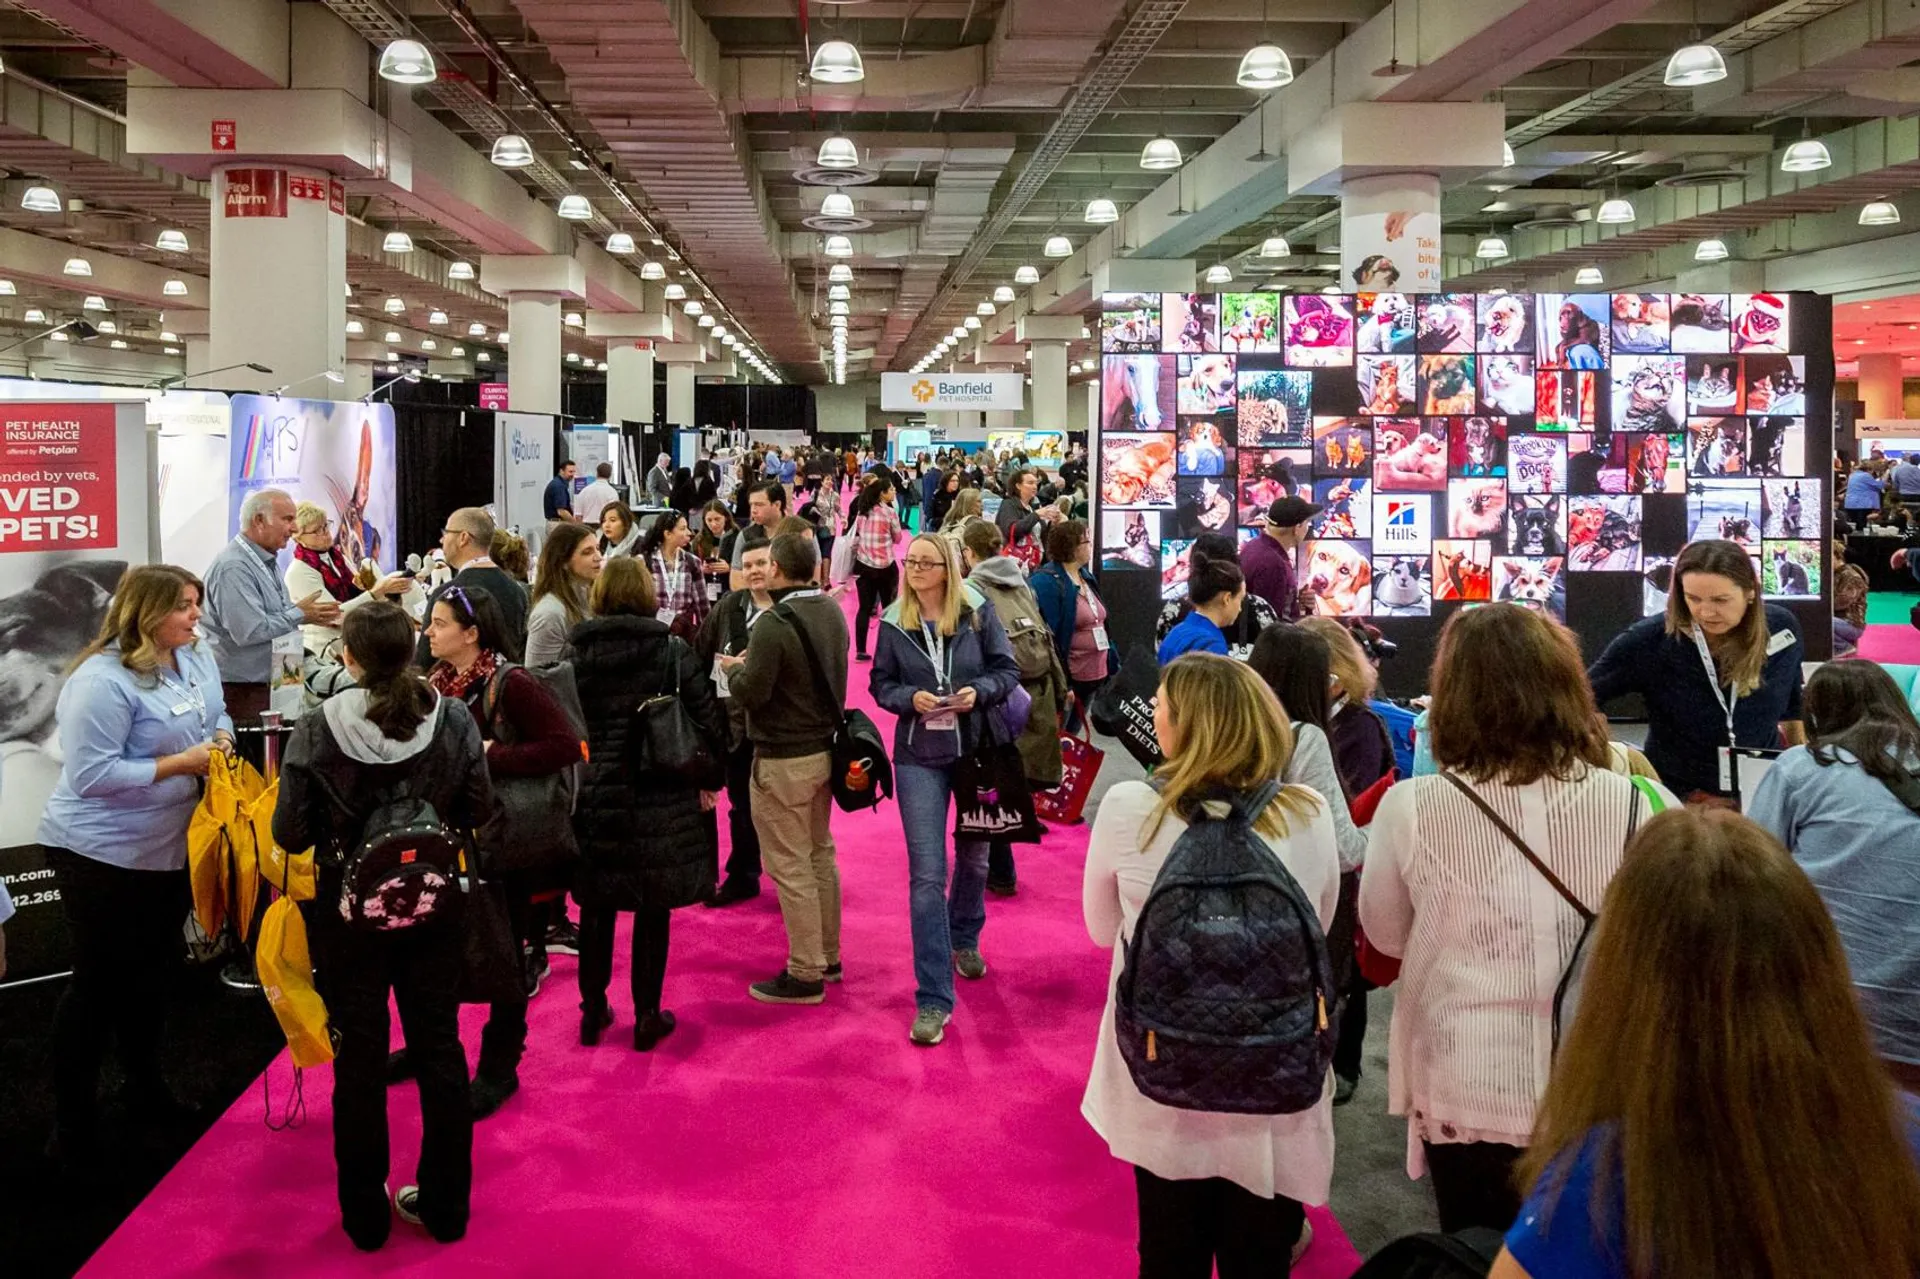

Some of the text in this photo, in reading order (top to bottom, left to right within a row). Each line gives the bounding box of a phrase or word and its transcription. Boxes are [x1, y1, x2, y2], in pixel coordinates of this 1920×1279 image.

[227, 194, 267, 205] Alarm
[938, 382, 992, 394] Banfield
[6, 421, 80, 430] PET HEALTH
[6, 431, 80, 441] INSURANCE
[39, 445, 78, 456] Petplan
[0, 470, 100, 483] nded by vets,
[0, 515, 98, 542] PETS!
[1385, 528, 1418, 541] Hill's
[1126, 724, 1160, 755] DIETS
